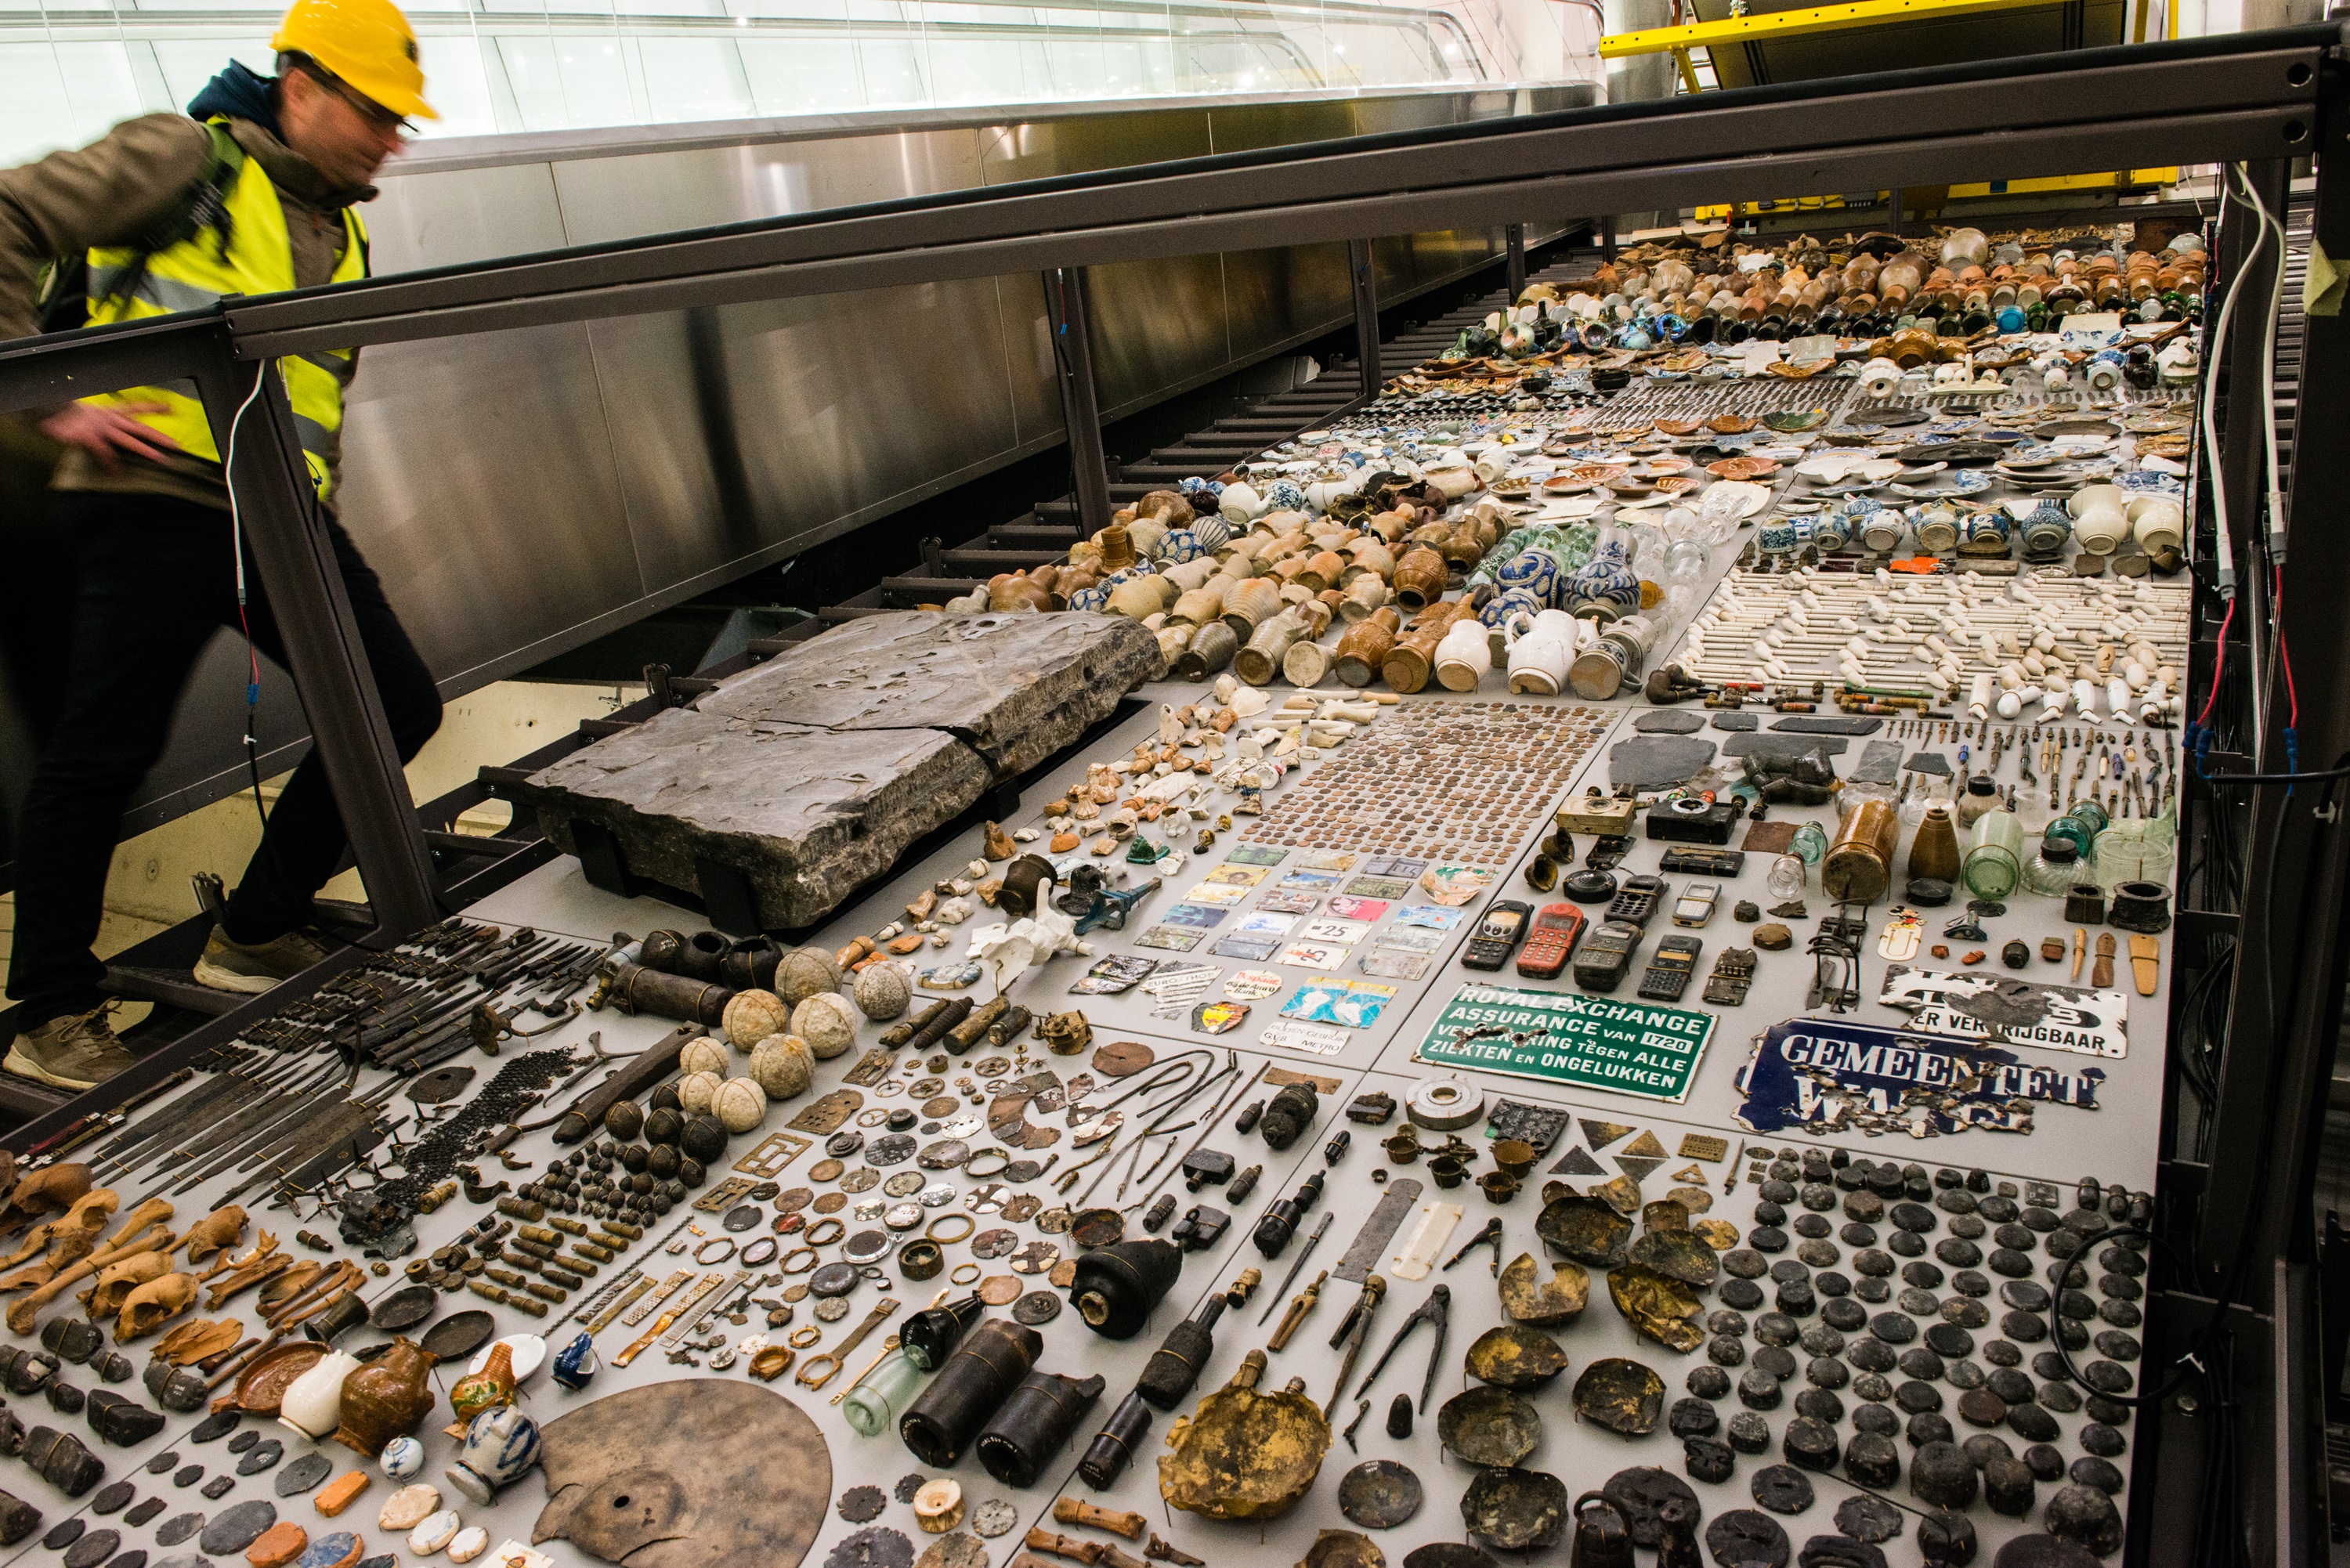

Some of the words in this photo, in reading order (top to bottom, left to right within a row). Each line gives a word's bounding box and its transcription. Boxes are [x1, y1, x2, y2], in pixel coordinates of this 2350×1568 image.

[1321, 925, 1350, 938] 25
[1300, 948, 1328, 963] 25
[1458, 989, 1544, 1009] ROYAL
[1551, 996, 1705, 1035] EXCHANGE
[1448, 1007, 1601, 1035] ASSURANCE
[1603, 1029, 1636, 1042] VAN
[1647, 1033, 1687, 1050] 1720
[1301, 1040, 1340, 1051] METRO
[1578, 1042, 1629, 1060] TEGEN
[1633, 1052, 1687, 1072] ALLE
[1428, 1039, 1513, 1061] ZIEKTEN
[1515, 1054, 1535, 1064] EN
[1541, 1053, 1676, 1089] ONGELUKKEN
